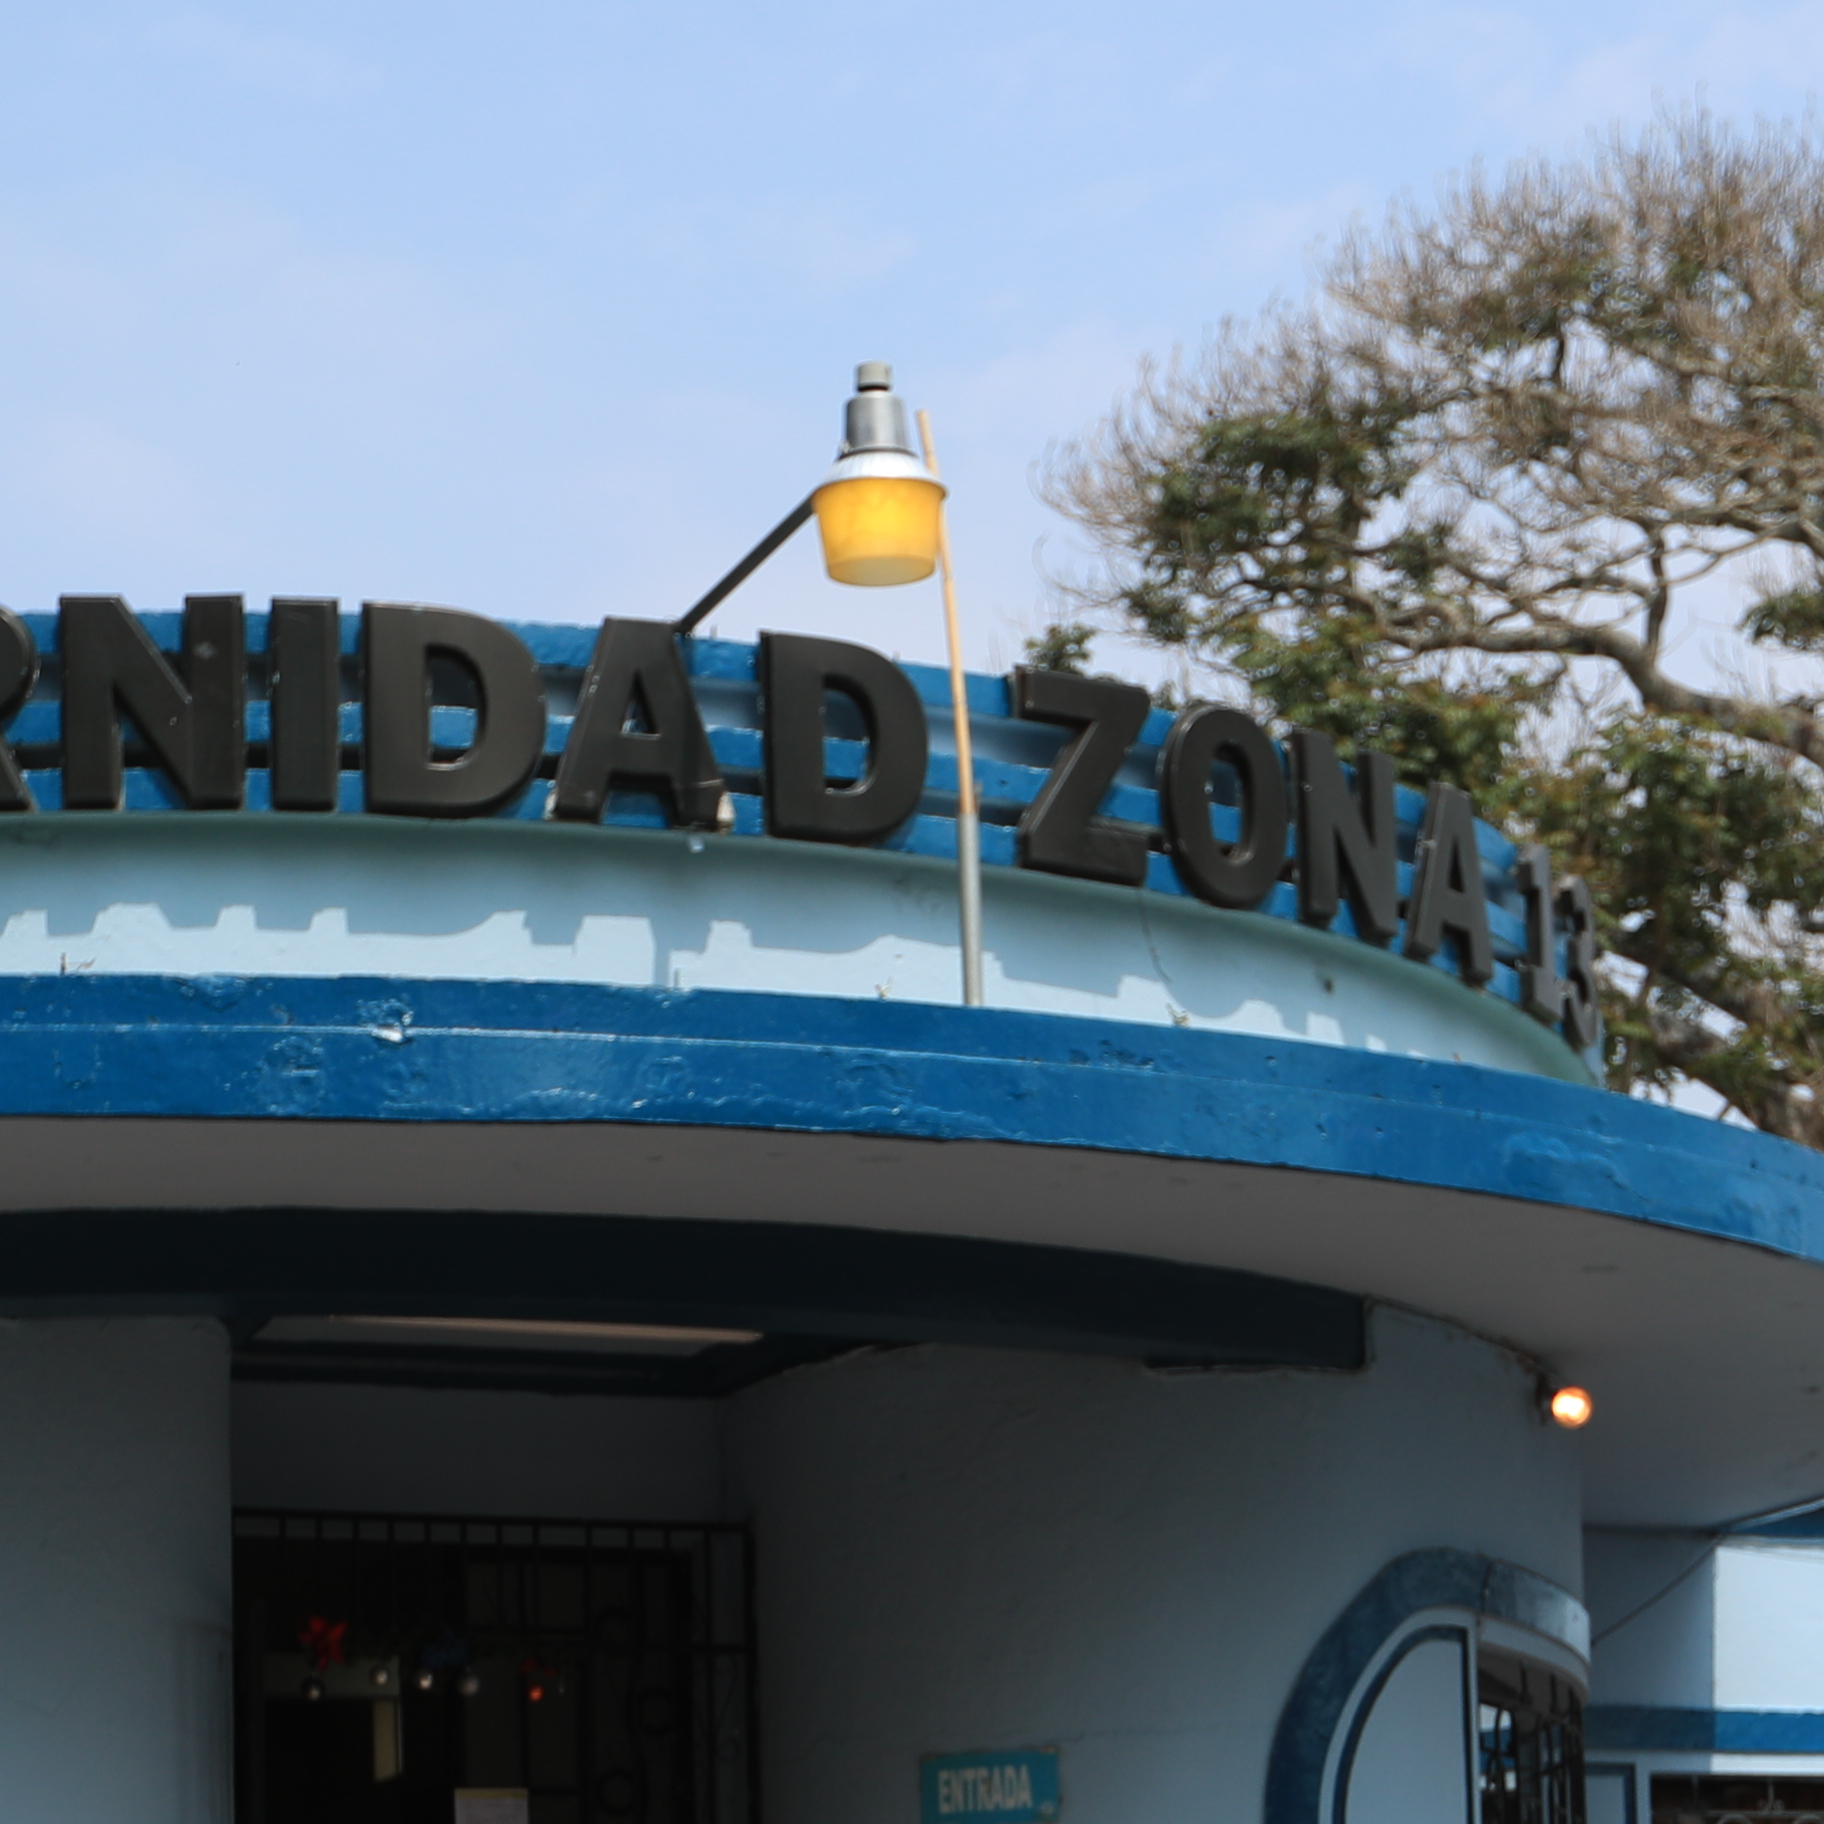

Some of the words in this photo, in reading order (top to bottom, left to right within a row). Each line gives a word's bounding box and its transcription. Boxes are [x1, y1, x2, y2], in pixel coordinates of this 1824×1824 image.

[1012, 664, 1492, 988] ZONA
[1516, 842, 1598, 1056] 13
[937, 1764, 1033, 1814] ENTRADA
